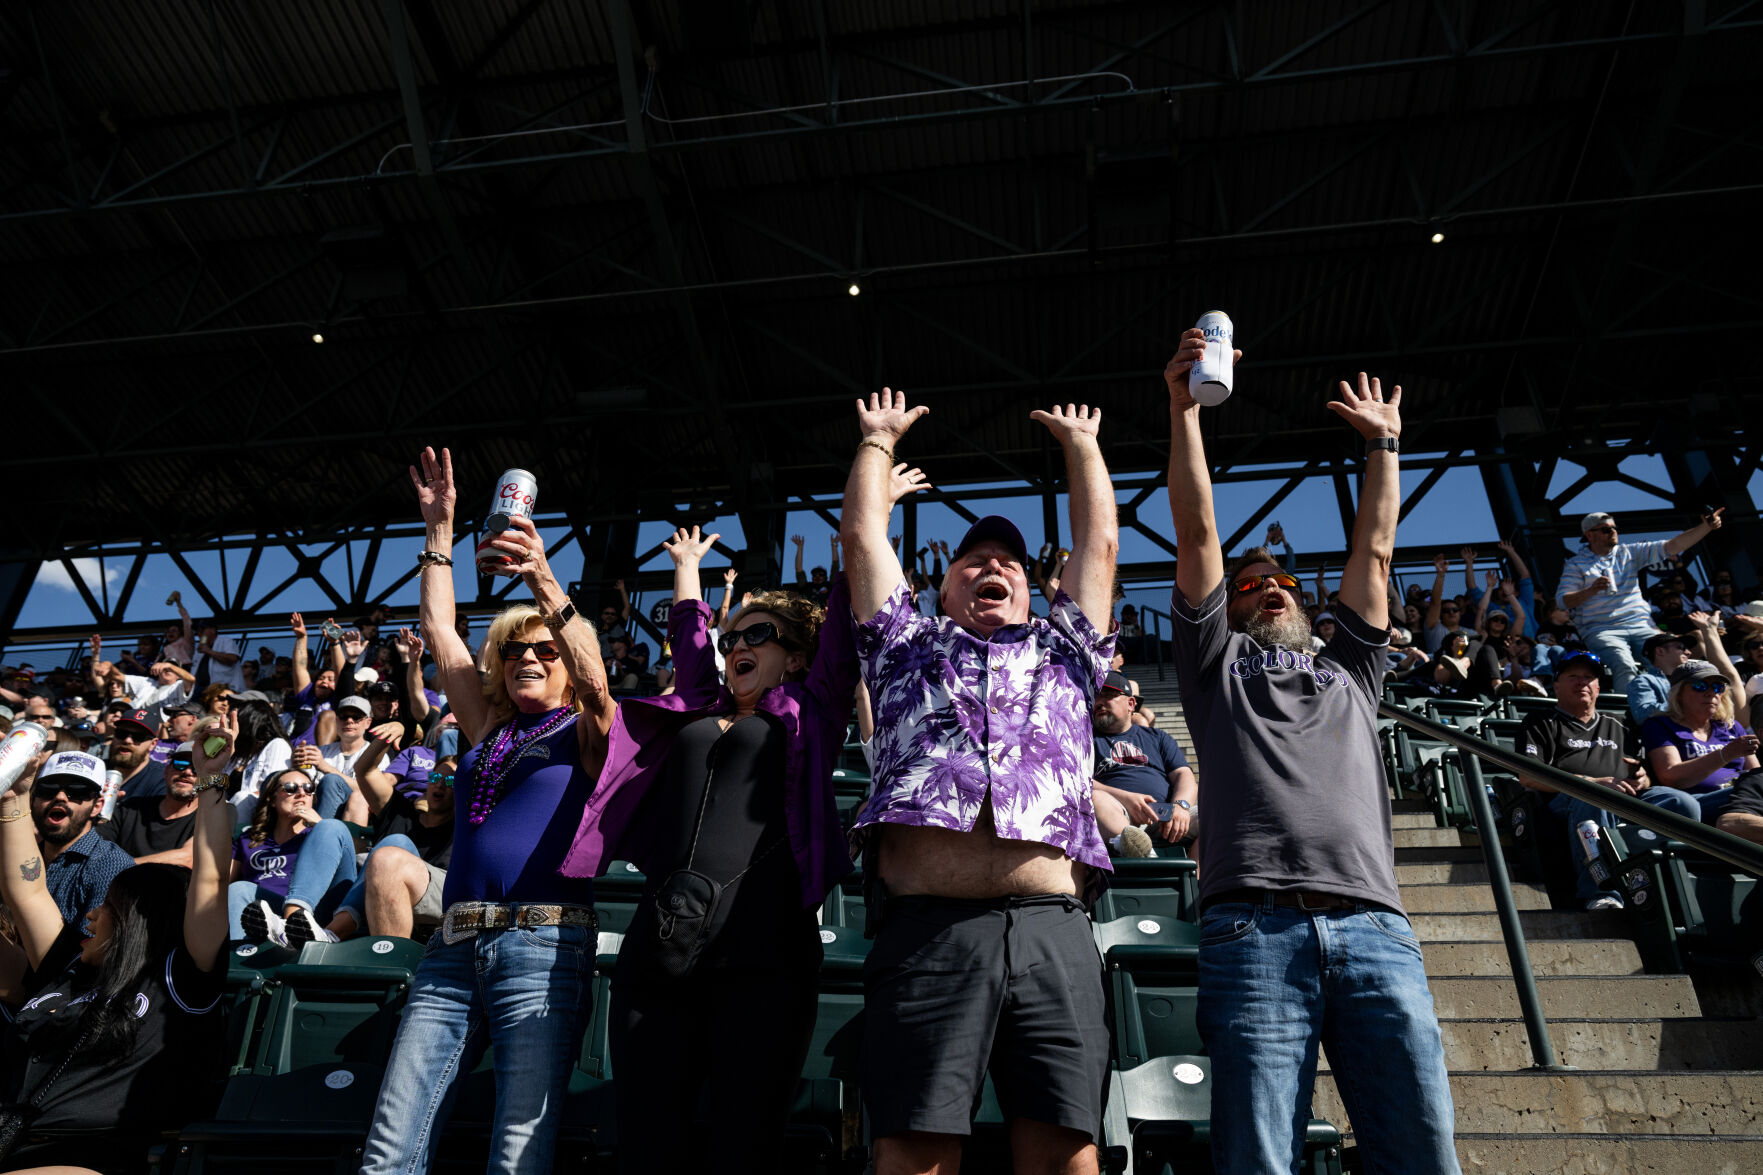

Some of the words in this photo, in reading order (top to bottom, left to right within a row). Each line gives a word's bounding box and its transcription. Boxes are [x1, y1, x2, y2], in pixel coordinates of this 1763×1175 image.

[502, 499, 531, 518] LIGH
[654, 606, 670, 622] 31
[1229, 650, 1348, 688] COLORDO
[377, 943, 390, 951] 19
